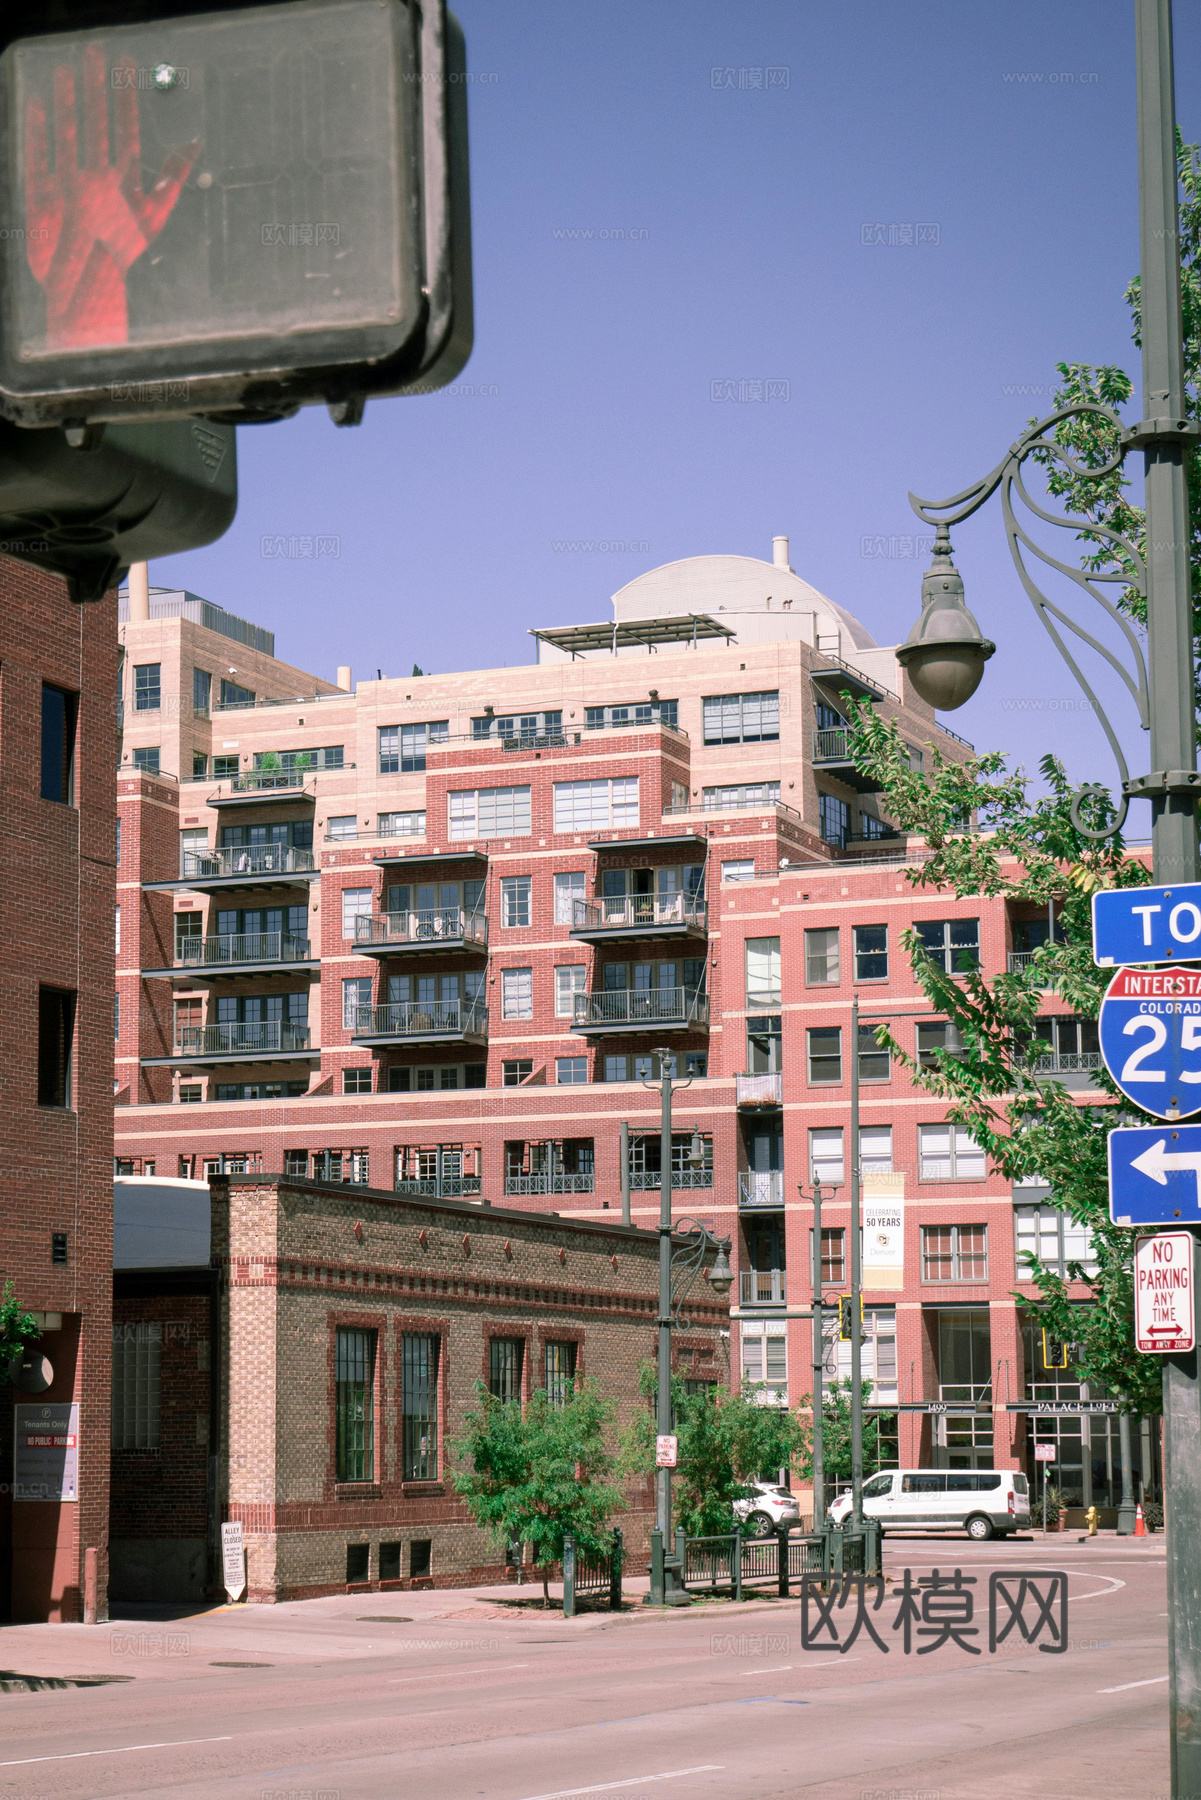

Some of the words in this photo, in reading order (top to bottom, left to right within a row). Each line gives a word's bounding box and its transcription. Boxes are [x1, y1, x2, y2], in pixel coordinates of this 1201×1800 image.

[1131, 902, 1201, 946] TO
[866, 1208, 901, 1217] CELEBRATING
[866, 1218, 876, 1227] 50
[877, 1218, 901, 1227] YEARS
[1153, 1241, 1173, 1263] NO
[1139, 1267, 1188, 1290] PARKING
[1153, 1291, 1174, 1306] ANY
[1152, 1307, 1176, 1322] TIME
[1174, 1339, 1189, 1348] ZONE
[928, 1403, 947, 1413] 1499
[1037, 1403, 1084, 1412] PALACE
[24, 1420, 50, 1428] Tenants
[51, 1420, 68, 1430] Only
